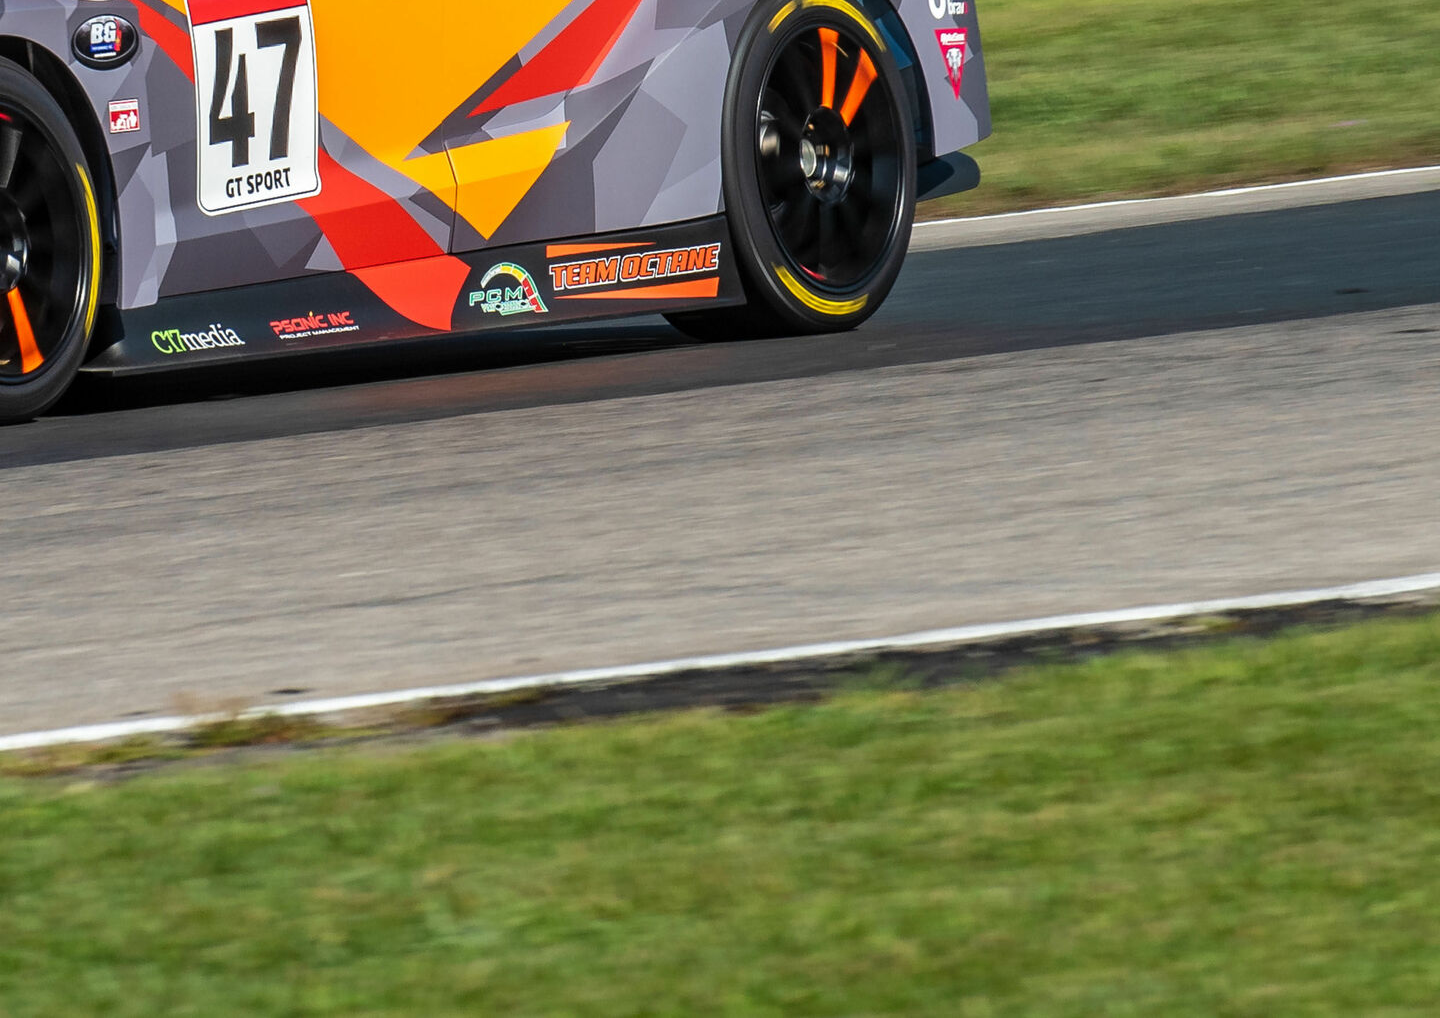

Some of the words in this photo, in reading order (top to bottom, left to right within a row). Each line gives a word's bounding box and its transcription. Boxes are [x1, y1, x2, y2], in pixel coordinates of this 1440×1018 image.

[90, 21, 117, 45] BG
[209, 15, 302, 168] 47
[226, 178, 242, 198] GT
[247, 168, 291, 193] SPORT
[549, 256, 620, 290] TEAM
[618, 243, 721, 282] OCTANE
[469, 285, 523, 307] PCM
[269, 312, 327, 335] PSONIC
[327, 311, 354, 327] INC
